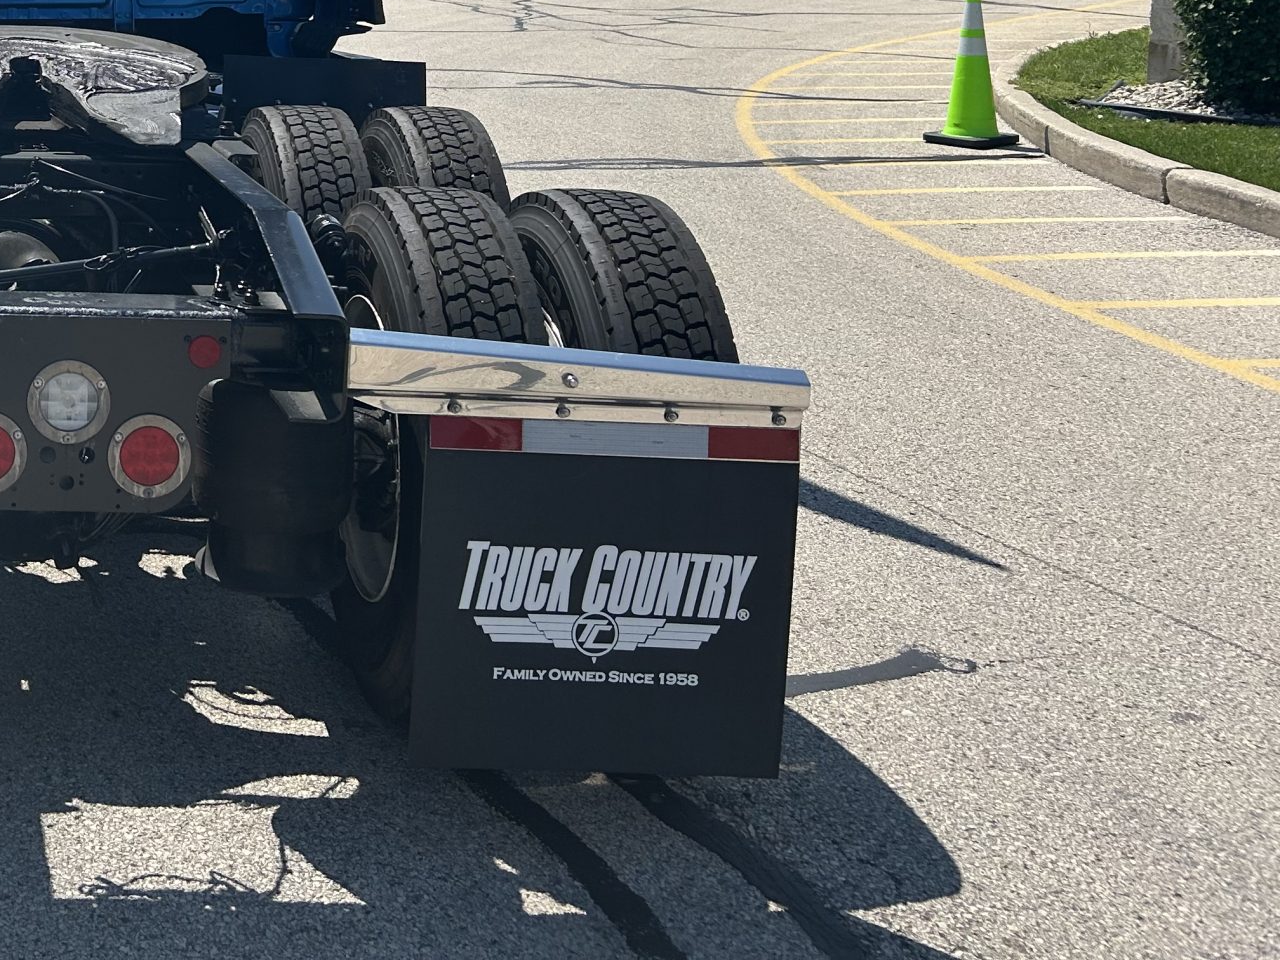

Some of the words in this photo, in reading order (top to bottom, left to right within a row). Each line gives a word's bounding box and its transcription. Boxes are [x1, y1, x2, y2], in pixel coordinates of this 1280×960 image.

[458, 540, 583, 613] TRUCK
[581, 544, 758, 620] COUNTRY
[492, 666, 548, 681] FAMILY
[548, 668, 606, 683] OWNED
[608, 670, 654, 685] SINCE
[658, 672, 699, 686] 1958
